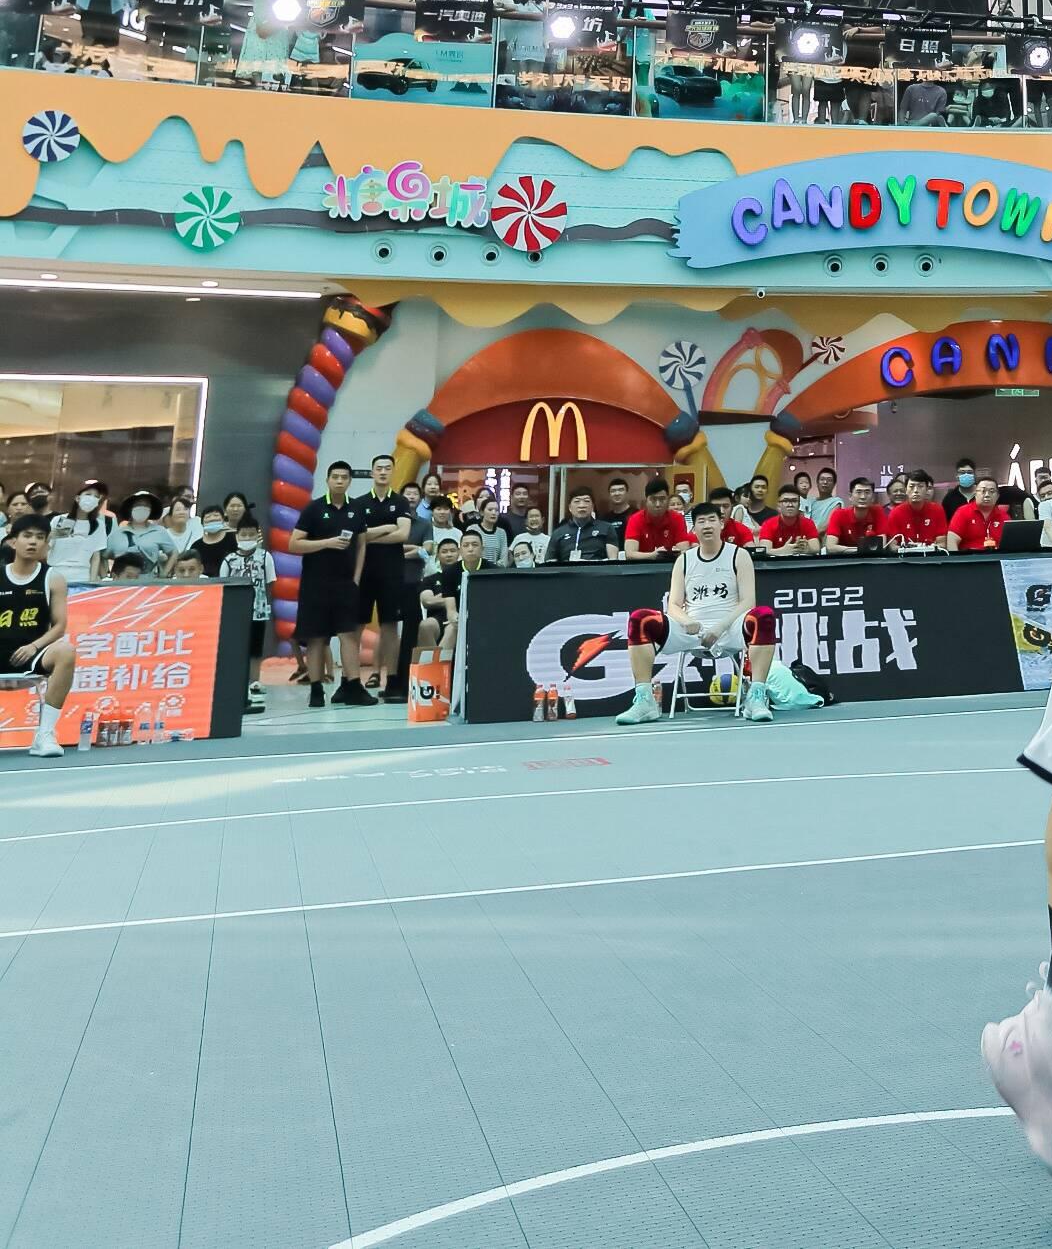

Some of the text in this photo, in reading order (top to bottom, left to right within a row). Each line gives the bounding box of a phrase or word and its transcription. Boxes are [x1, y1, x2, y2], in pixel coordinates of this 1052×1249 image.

[731, 175, 917, 246] CANDY
[692, 582, 729, 601] 潍坊
[774, 586, 864, 608] 2022
[70, 630, 195, 659] 学配比
[72, 661, 192, 694] 速补给
